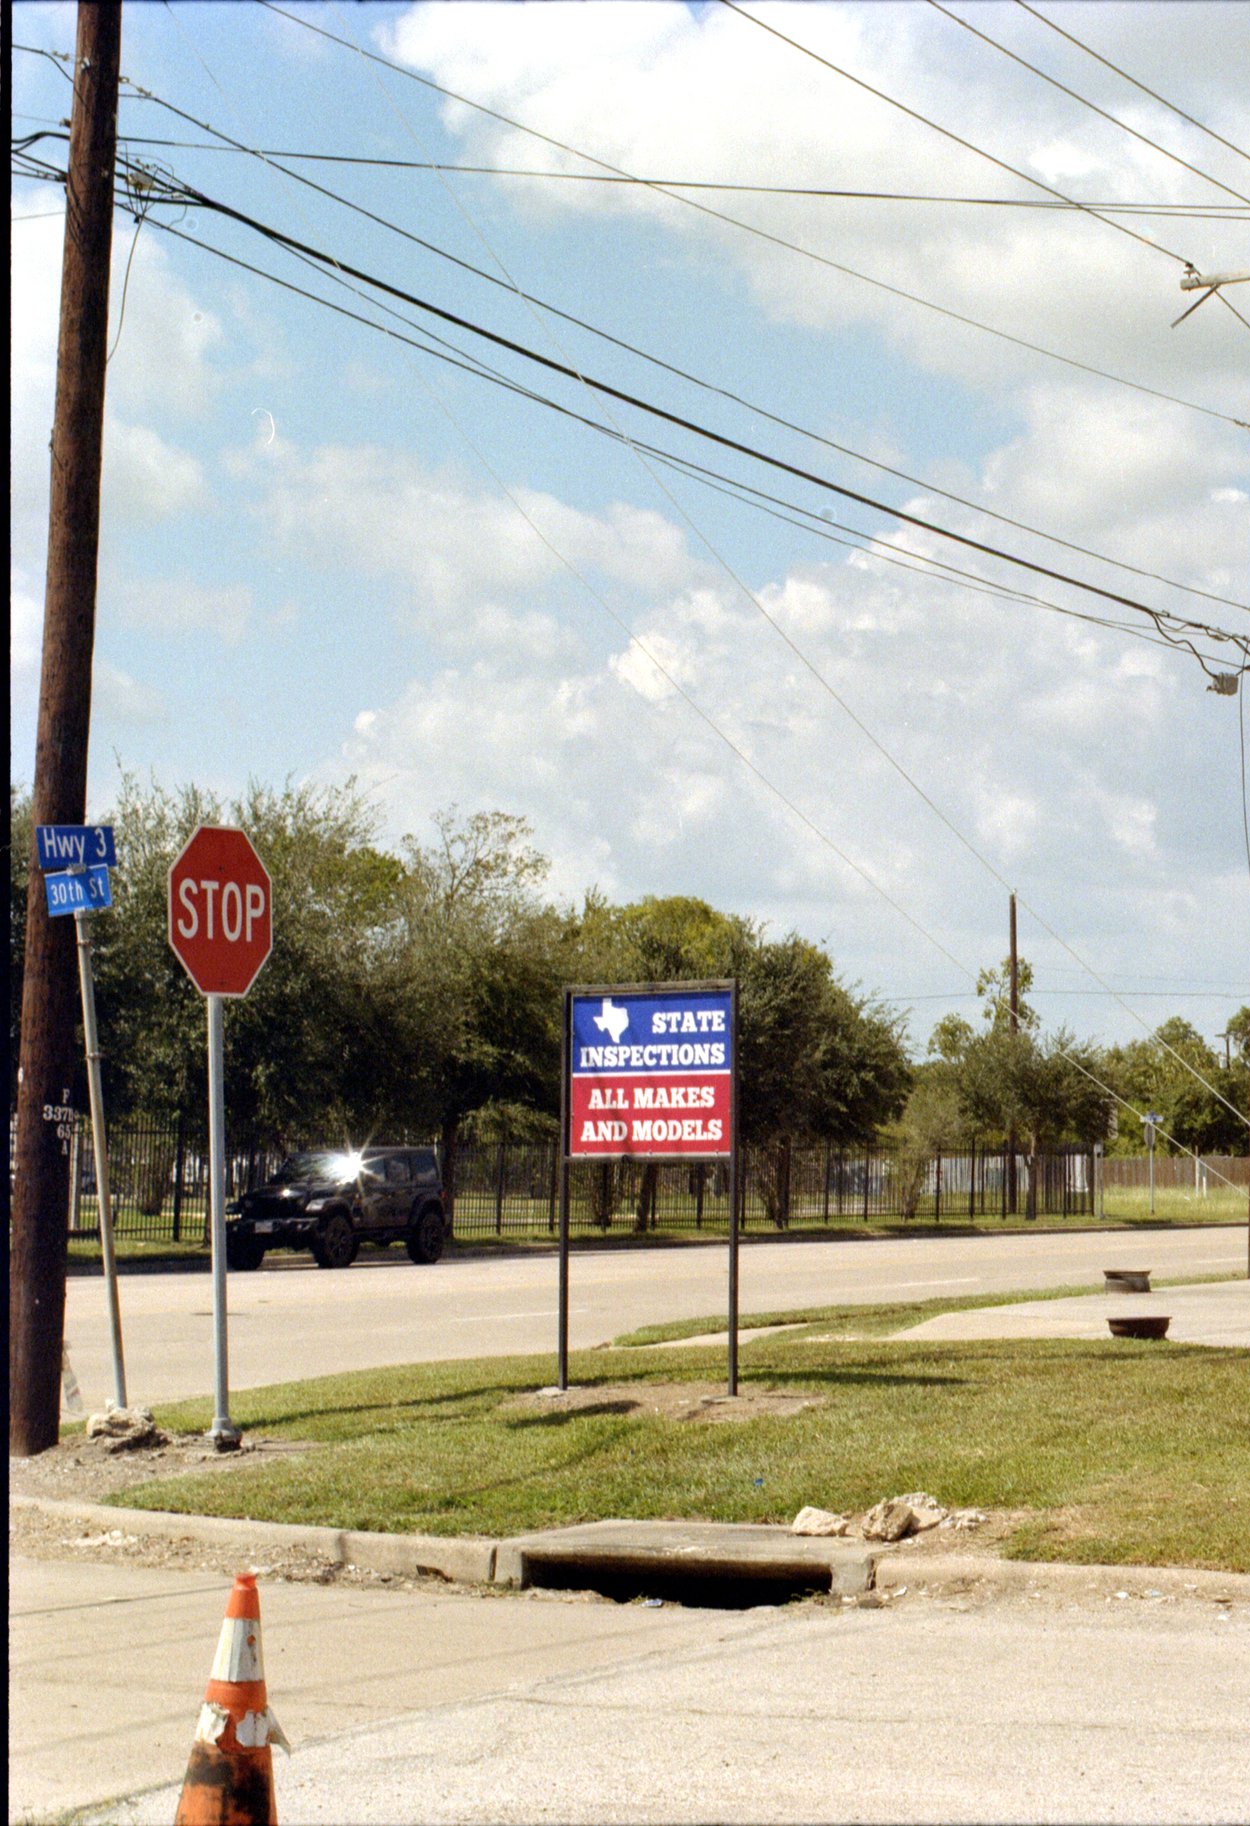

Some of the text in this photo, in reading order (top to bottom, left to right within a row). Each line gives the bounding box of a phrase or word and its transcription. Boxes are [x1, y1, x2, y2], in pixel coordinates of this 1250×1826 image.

[43, 827, 107, 863] Hwy 3
[50, 877, 105, 906] 30th St
[177, 878, 265, 942] STOP
[652, 1010, 725, 1033] STATE
[580, 1043, 725, 1068] INSPECTIONS
[588, 1086, 715, 1110] ALL MAKES
[580, 1119, 722, 1142] AND MODELS
